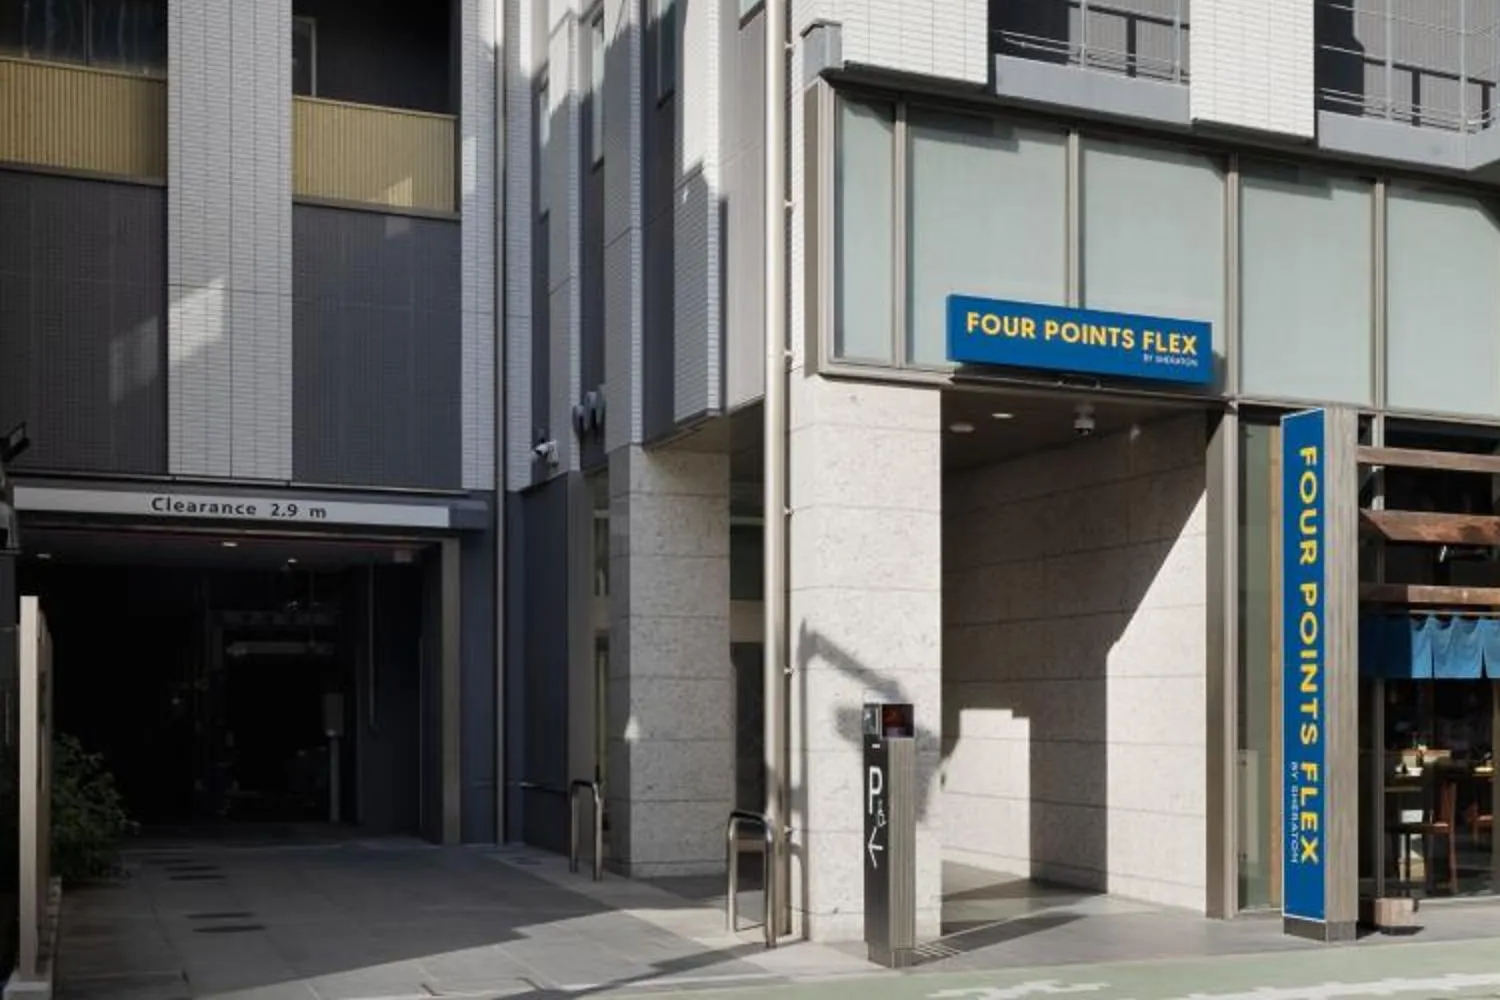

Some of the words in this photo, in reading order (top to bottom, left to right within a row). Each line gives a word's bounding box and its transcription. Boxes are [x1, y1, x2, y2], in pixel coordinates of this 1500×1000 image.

[967, 311, 1036, 339] FOUR
[1045, 320, 1135, 349] POINTS
[1143, 329, 1197, 355] FLEX
[151, 497, 257, 515] Clearance
[271, 503, 298, 517] 2.9
[309, 507, 327, 519] m
[1299, 446, 1318, 565] FOUR
[1300, 582, 1319, 745] POINTS
[868, 765, 883, 815] P
[1290, 761, 1299, 781] BY
[1300, 762, 1319, 864] FLEX
